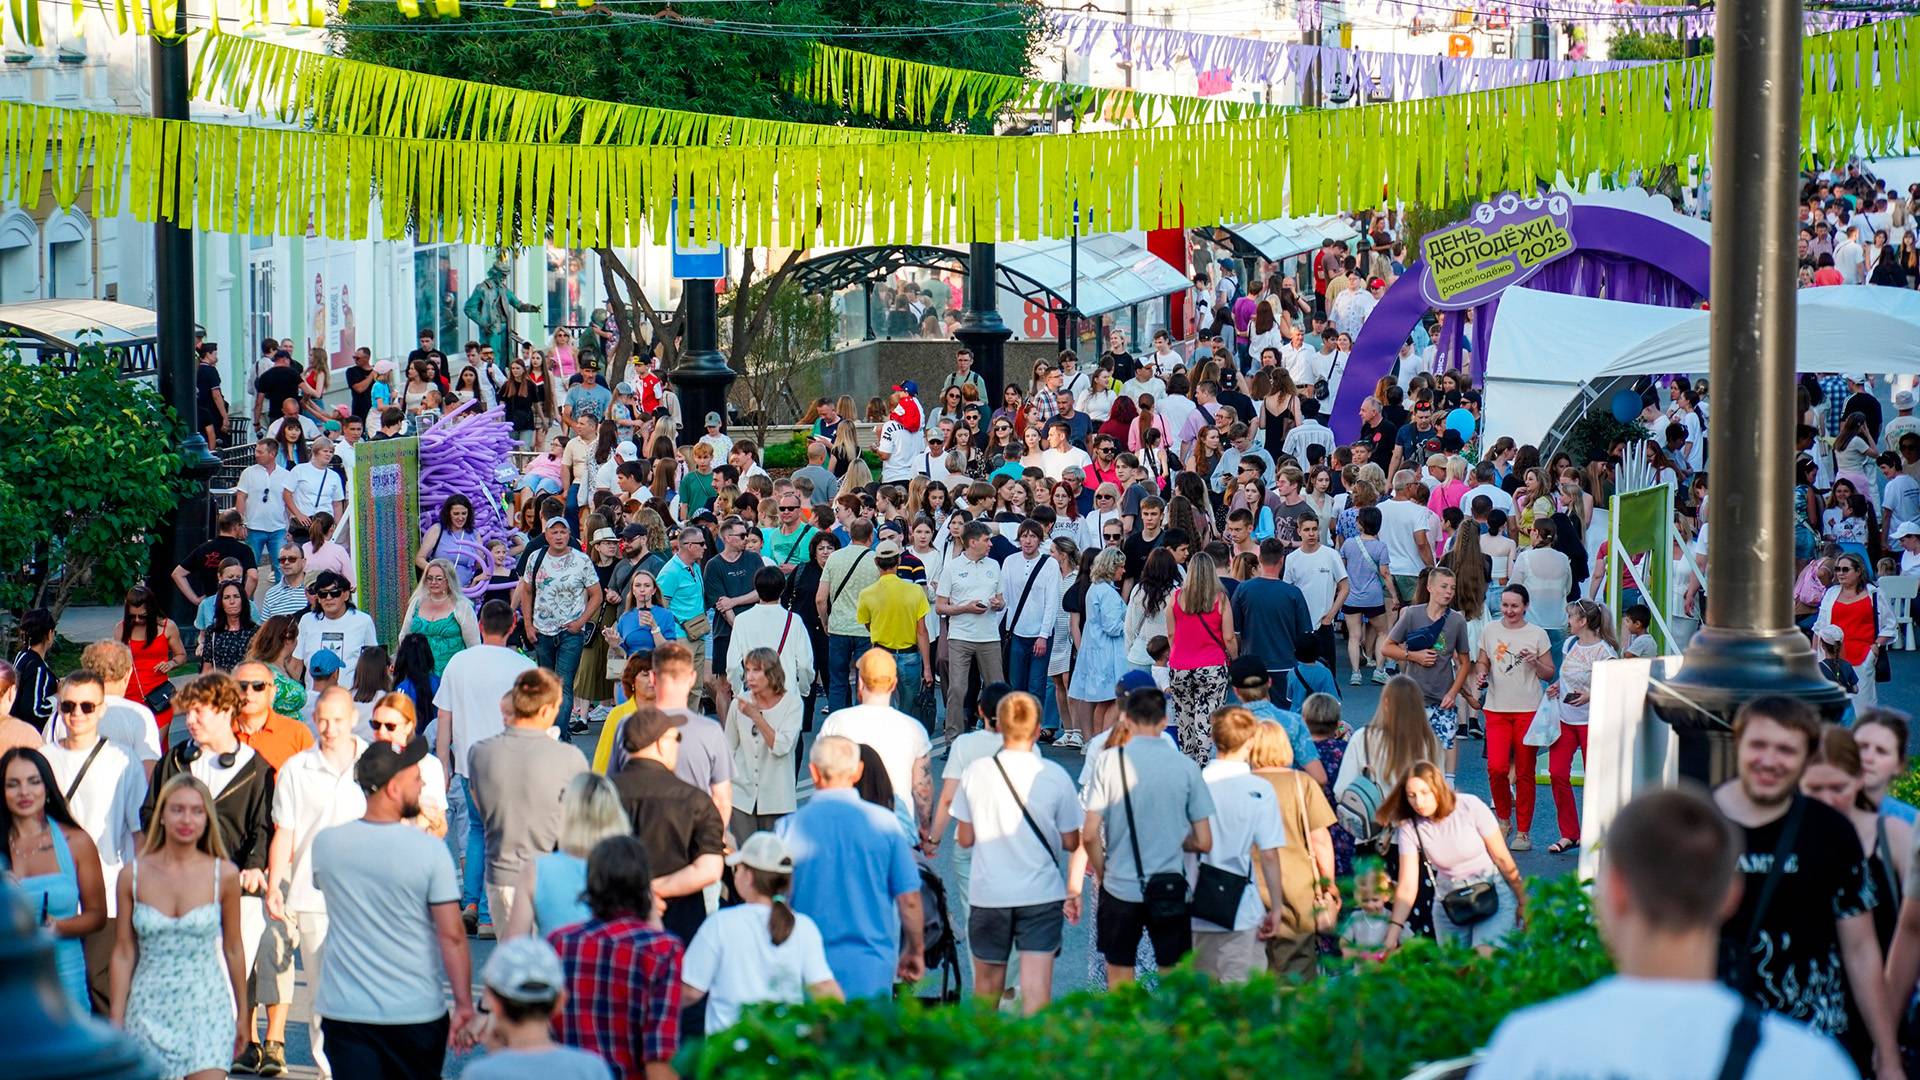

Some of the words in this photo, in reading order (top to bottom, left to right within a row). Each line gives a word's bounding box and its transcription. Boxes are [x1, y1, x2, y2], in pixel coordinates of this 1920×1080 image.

[1428, 229, 1481, 260] ДЕНЬ
[1434, 219, 1552, 274] МОЛОДЁЖИ
[1521, 232, 1567, 264] 2025
[1438, 271, 1464, 284] проект
[1465, 267, 1473, 276] от
[1442, 263, 1512, 296] росмолодёжь
